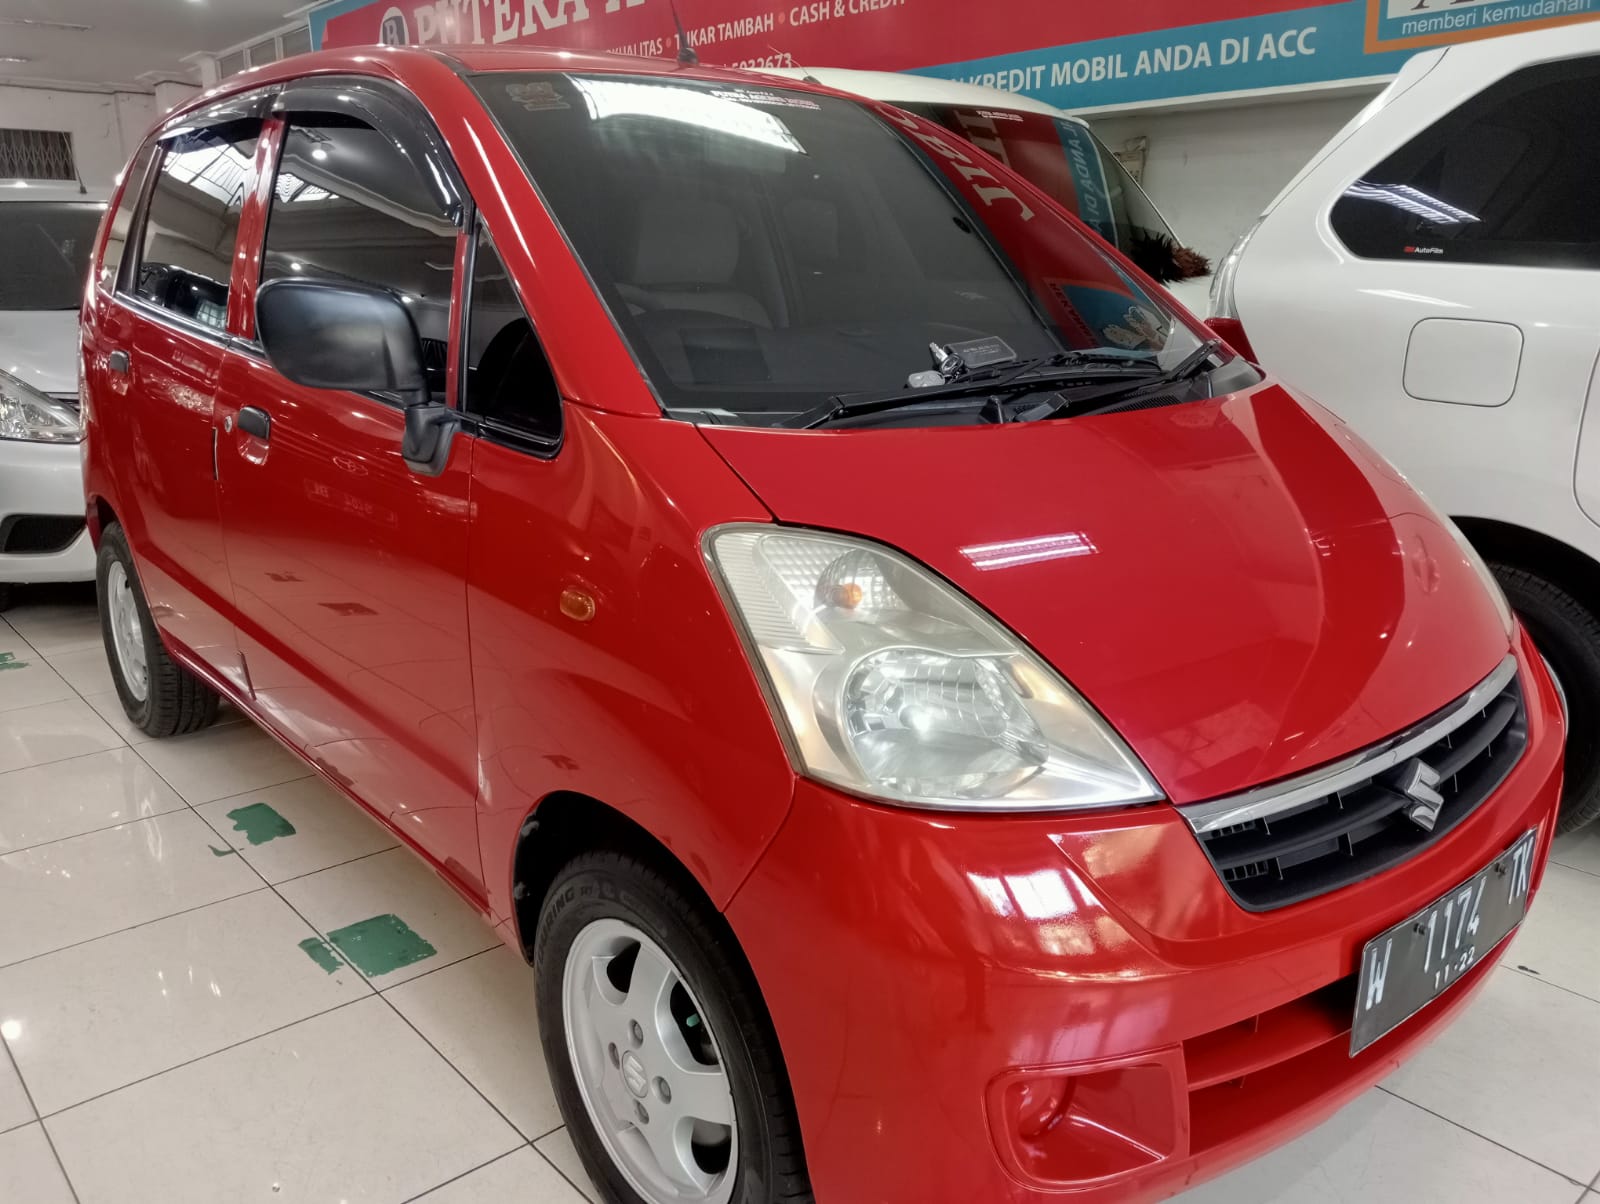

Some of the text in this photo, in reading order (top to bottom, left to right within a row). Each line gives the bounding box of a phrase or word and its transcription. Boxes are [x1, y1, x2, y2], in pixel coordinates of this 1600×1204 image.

[717, 14, 774, 43] TAMBAH
[790, 1, 830, 26] CASH
[834, 0, 845, 17] &
[1402, 9, 1477, 34] memberi
[1051, 54, 1128, 88] MOBIL
[1135, 42, 1212, 76] ANDA
[1220, 37, 1249, 65] DI
[1258, 27, 1317, 60] ACC
[1365, 938, 1393, 1011] W
[1424, 876, 1487, 973] 1174
